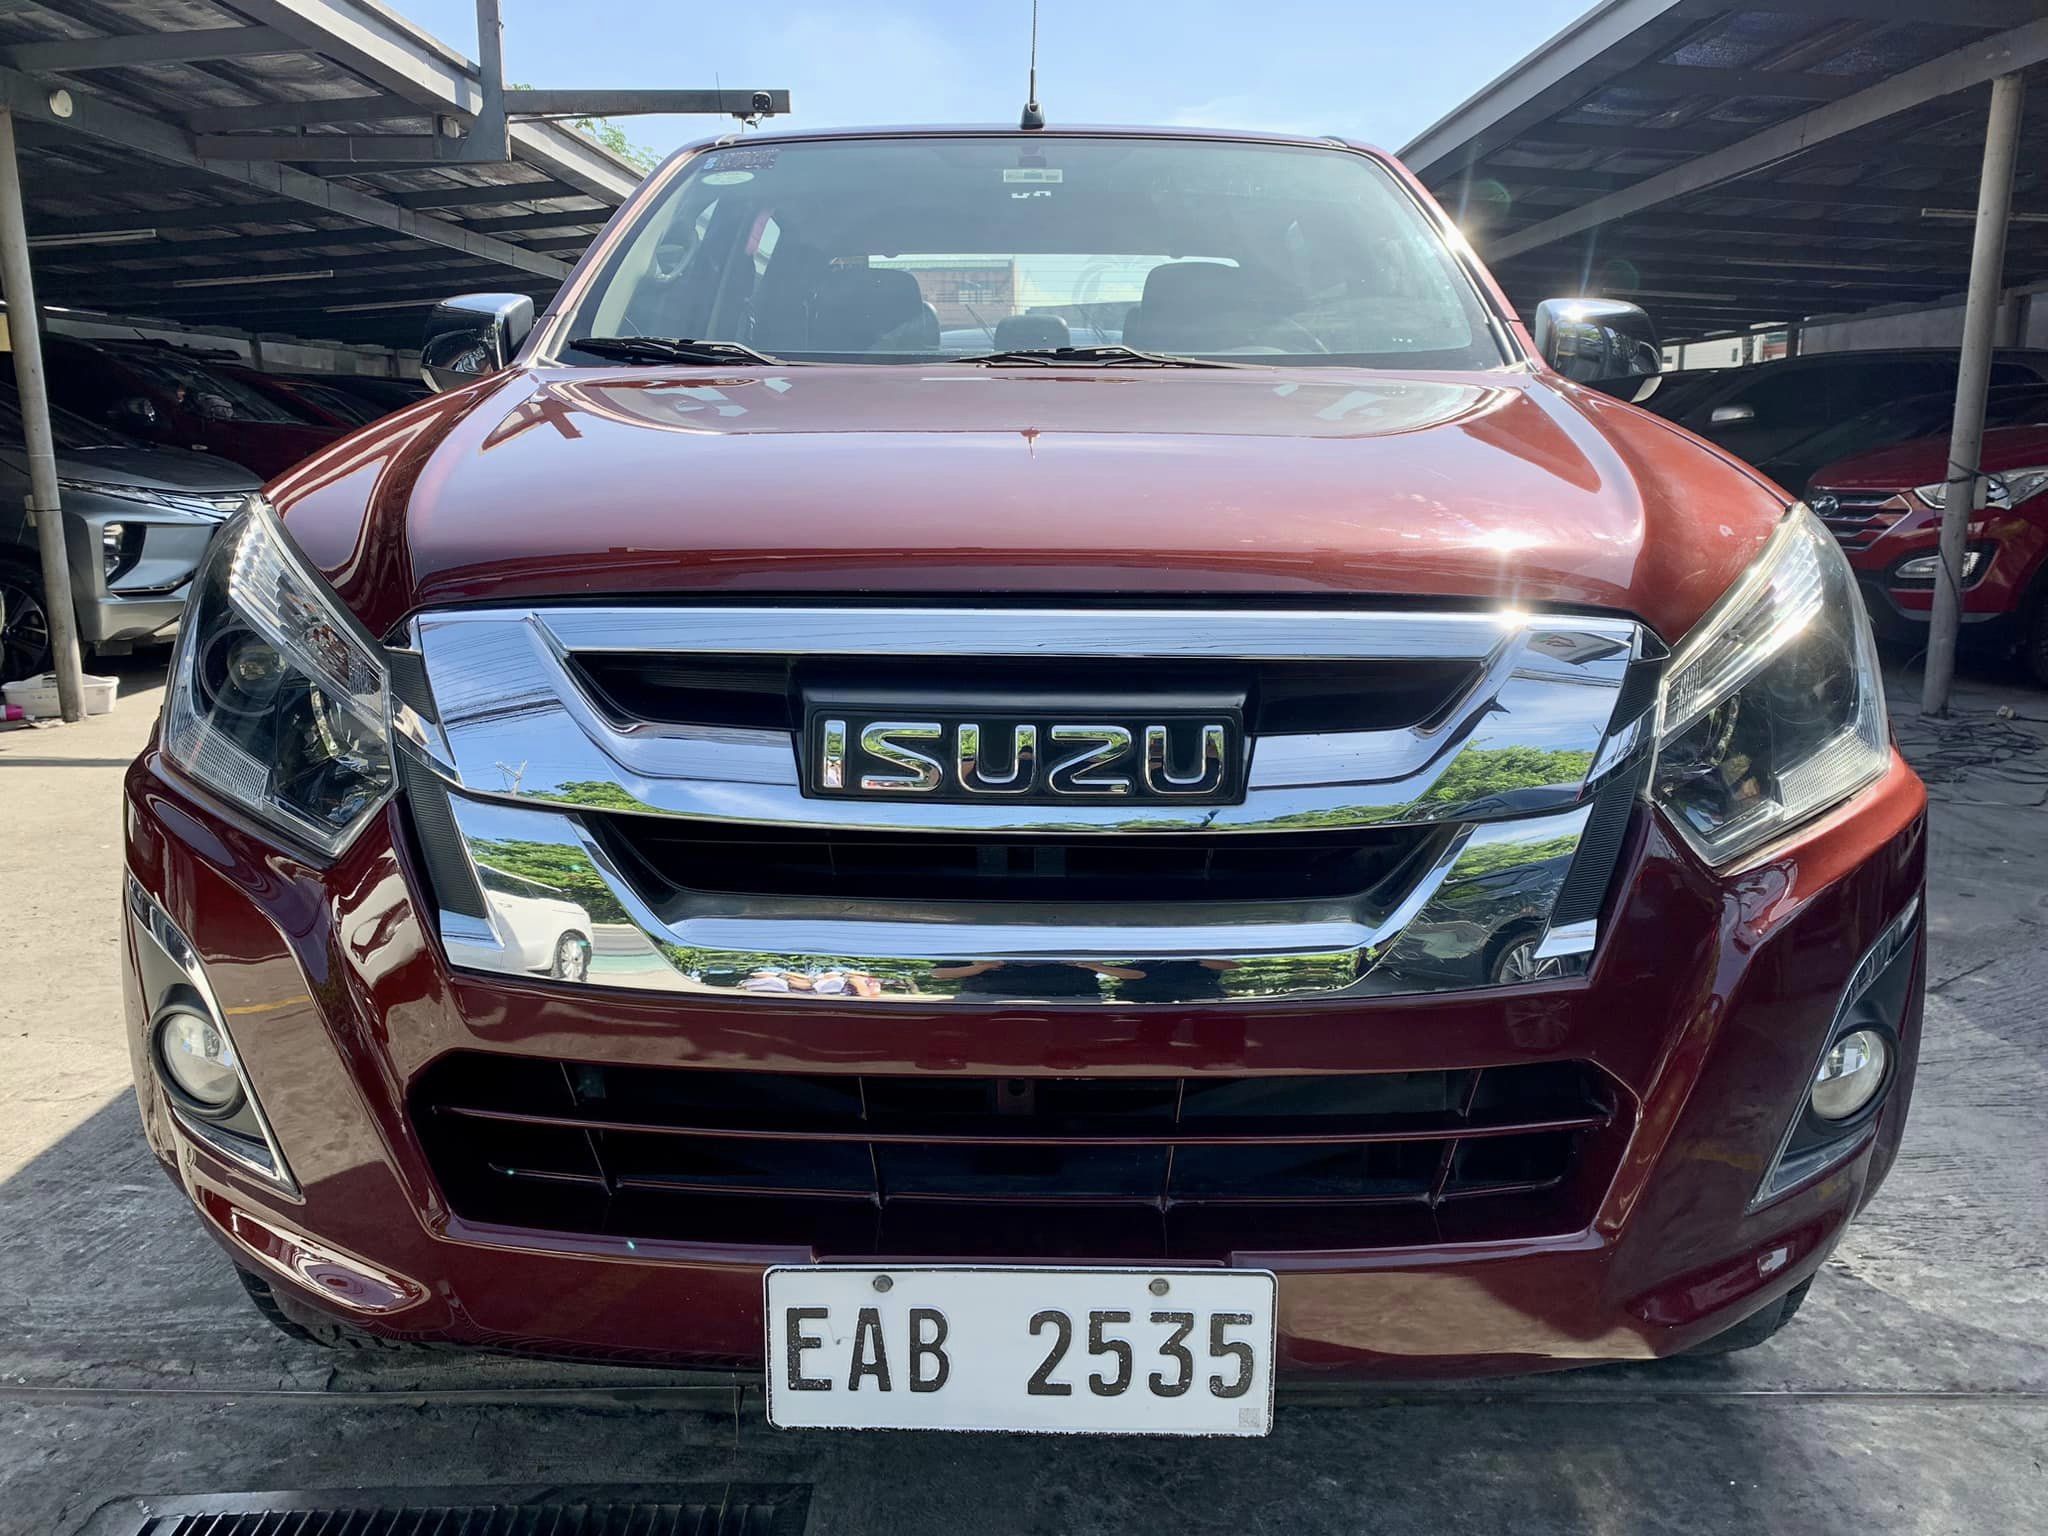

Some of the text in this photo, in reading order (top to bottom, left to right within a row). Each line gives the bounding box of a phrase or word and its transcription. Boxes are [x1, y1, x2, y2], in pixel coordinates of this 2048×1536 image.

[823, 720, 1225, 794] ISUZU
[785, 1306, 1255, 1399] EAB 2535
